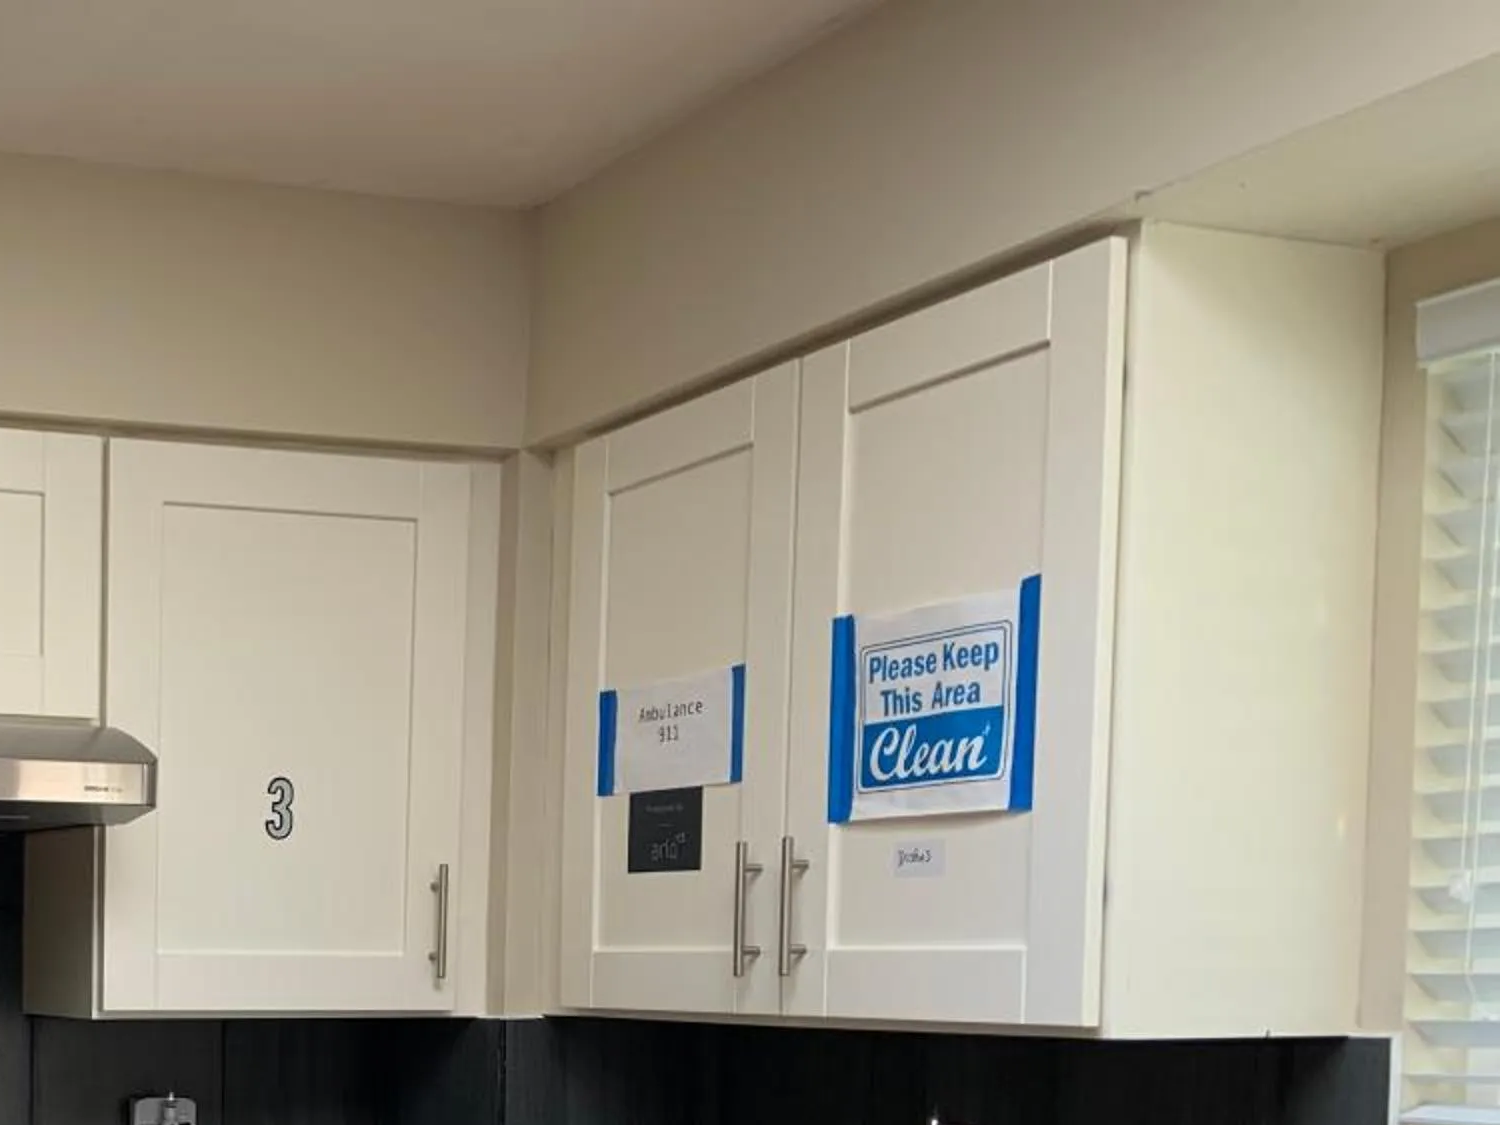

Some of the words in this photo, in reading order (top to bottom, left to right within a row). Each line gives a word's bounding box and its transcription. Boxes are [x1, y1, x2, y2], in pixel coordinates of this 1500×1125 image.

[869, 652, 937, 684] Please
[943, 641, 999, 671] Keep
[638, 701, 703, 722] Ambulance
[880, 687, 923, 717] This
[931, 681, 981, 709] Area
[659, 725, 679, 742] 911
[869, 723, 988, 781] Clean
[265, 776, 295, 840] 3
